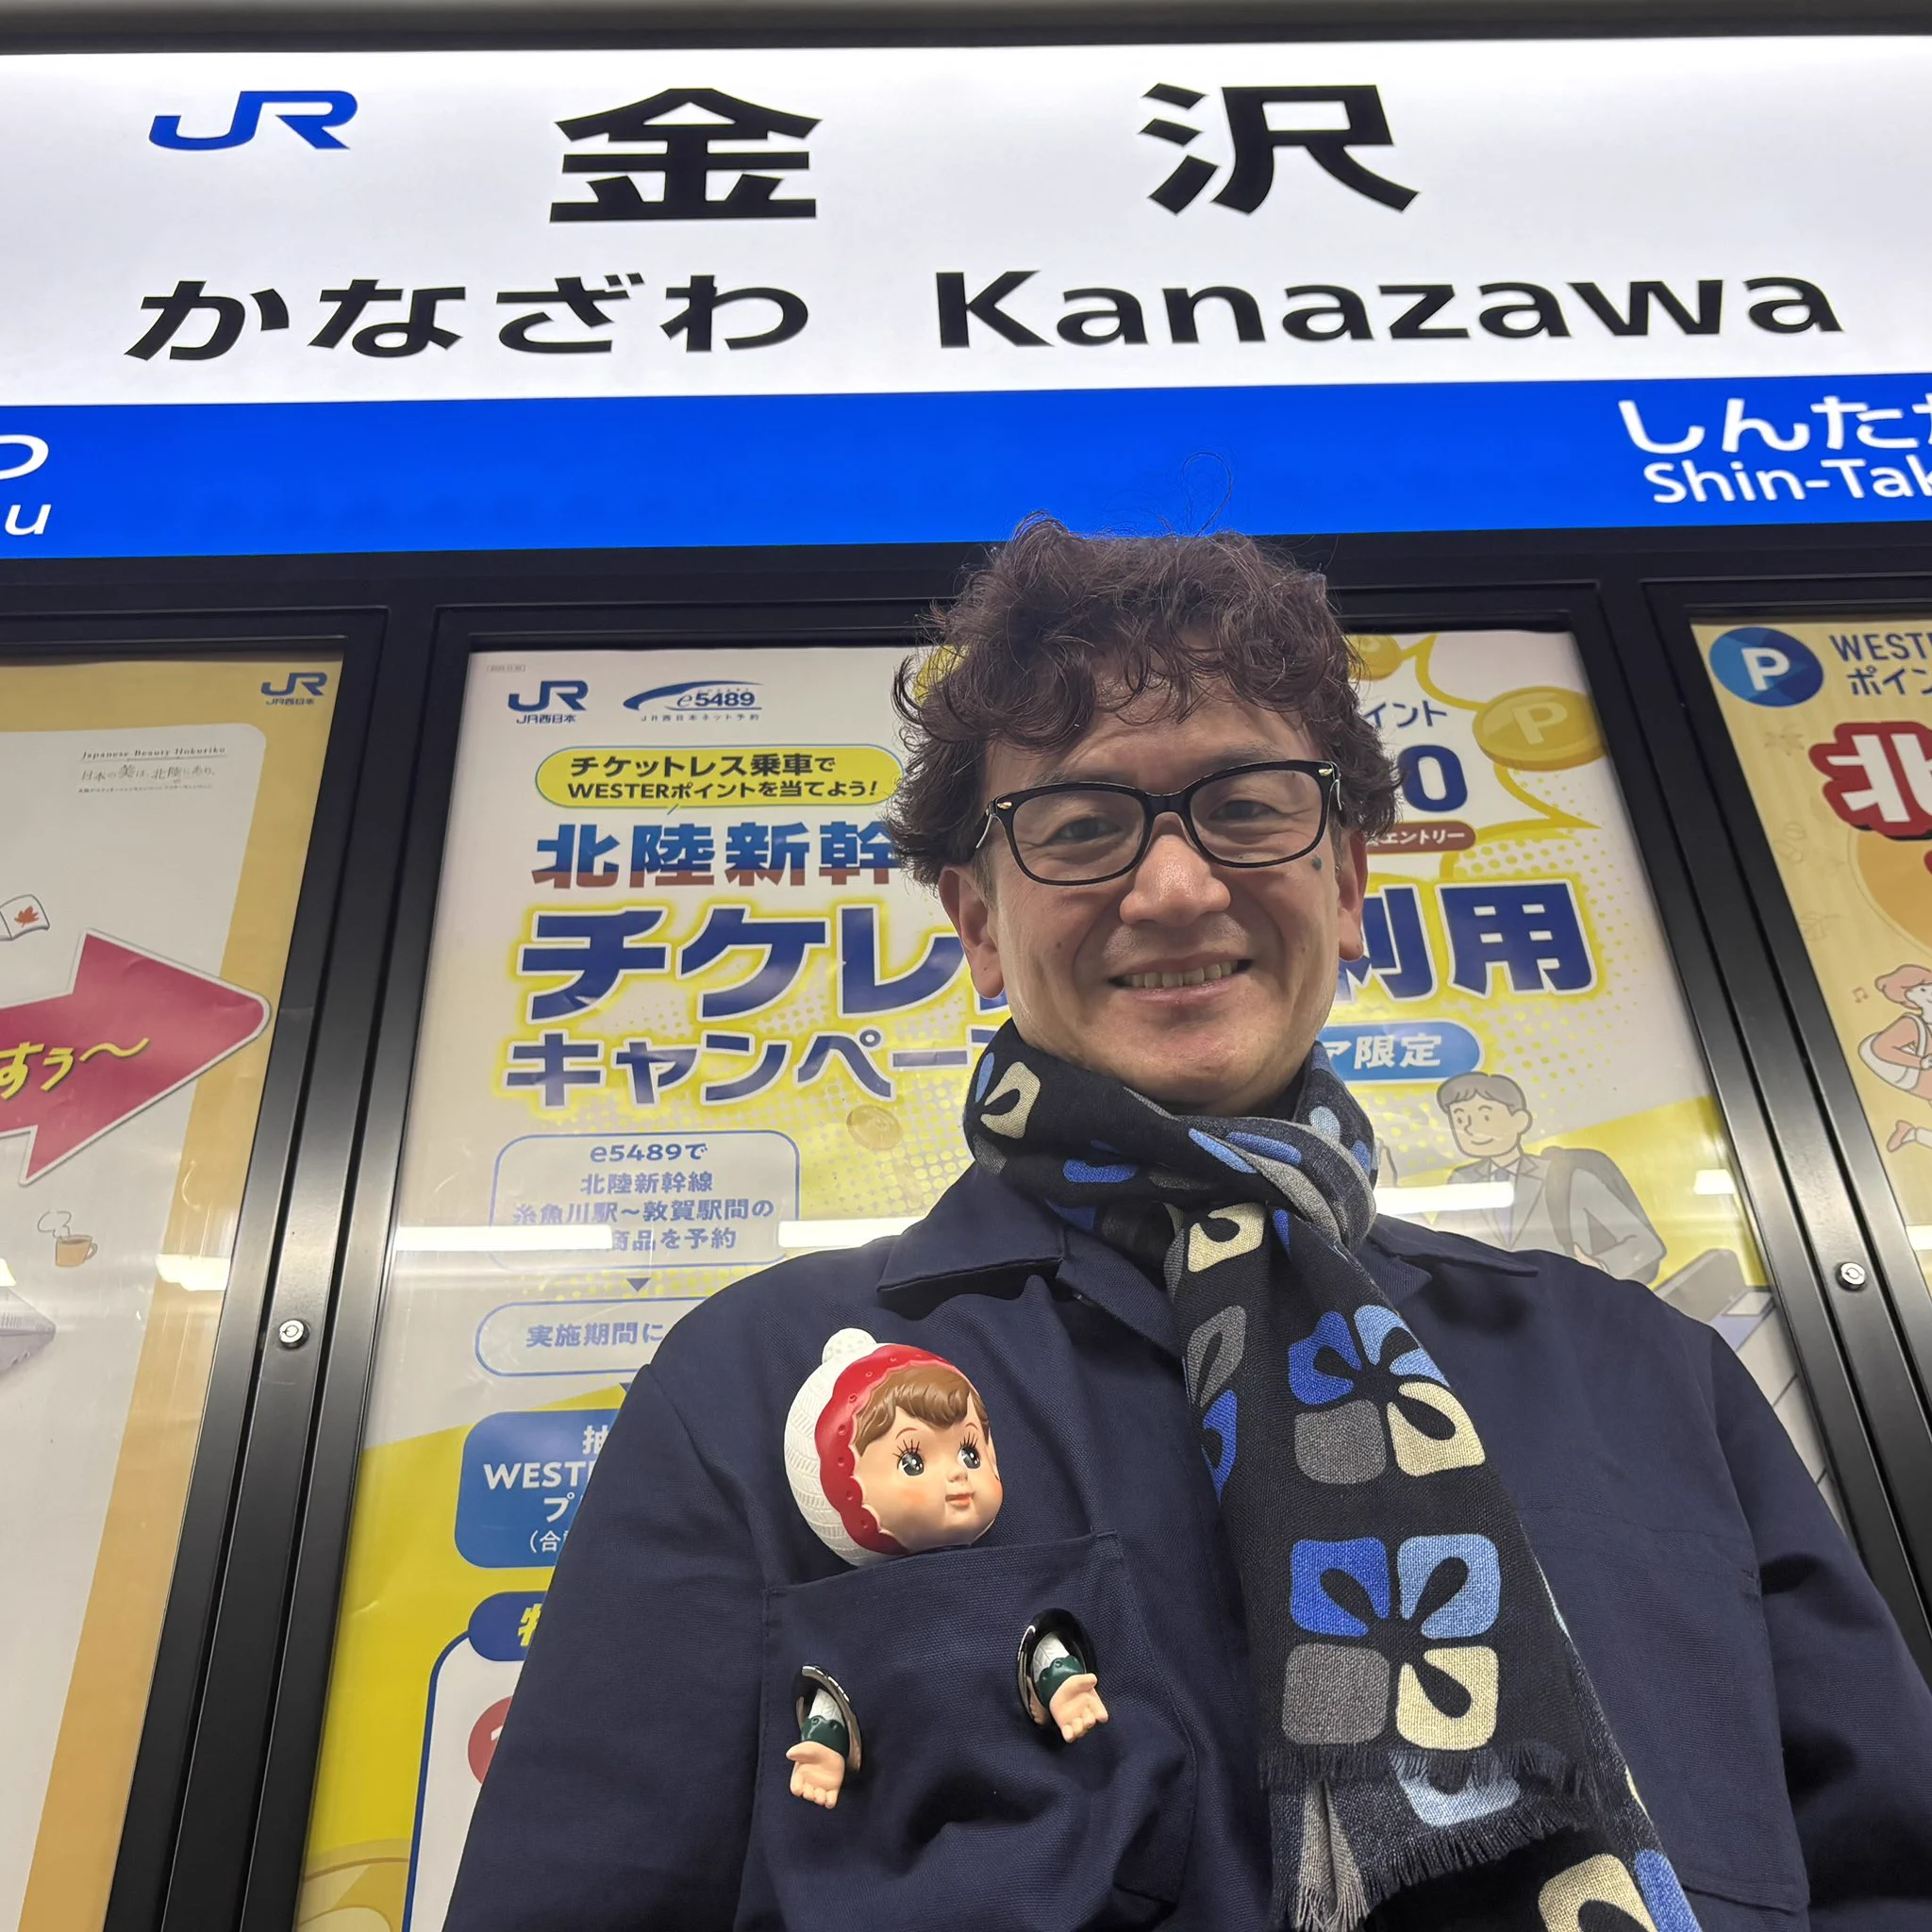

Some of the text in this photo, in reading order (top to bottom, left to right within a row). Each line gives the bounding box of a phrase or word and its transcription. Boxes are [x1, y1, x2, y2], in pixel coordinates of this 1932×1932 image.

[149, 91, 358, 151] JR
[125, 272, 809, 360] かなざわ
[934, 270, 1843, 349] Kanazawa
[1828, 632, 1932, 662] WEST
[260, 672, 327, 696] JR
[508, 680, 589, 712] JR
[676, 691, 756, 708] e5489
[516, 714, 576, 724] JR西日本
[570, 753, 836, 778] チケットレス乗車で
[506, 1028, 1000, 1108] キャンペー
[590, 1142, 708, 1163] e5489で
[580, 1171, 713, 1195] 北陸新幹線
[526, 1322, 663, 1347] 実施期間に
[484, 1459, 596, 1490] WEST
